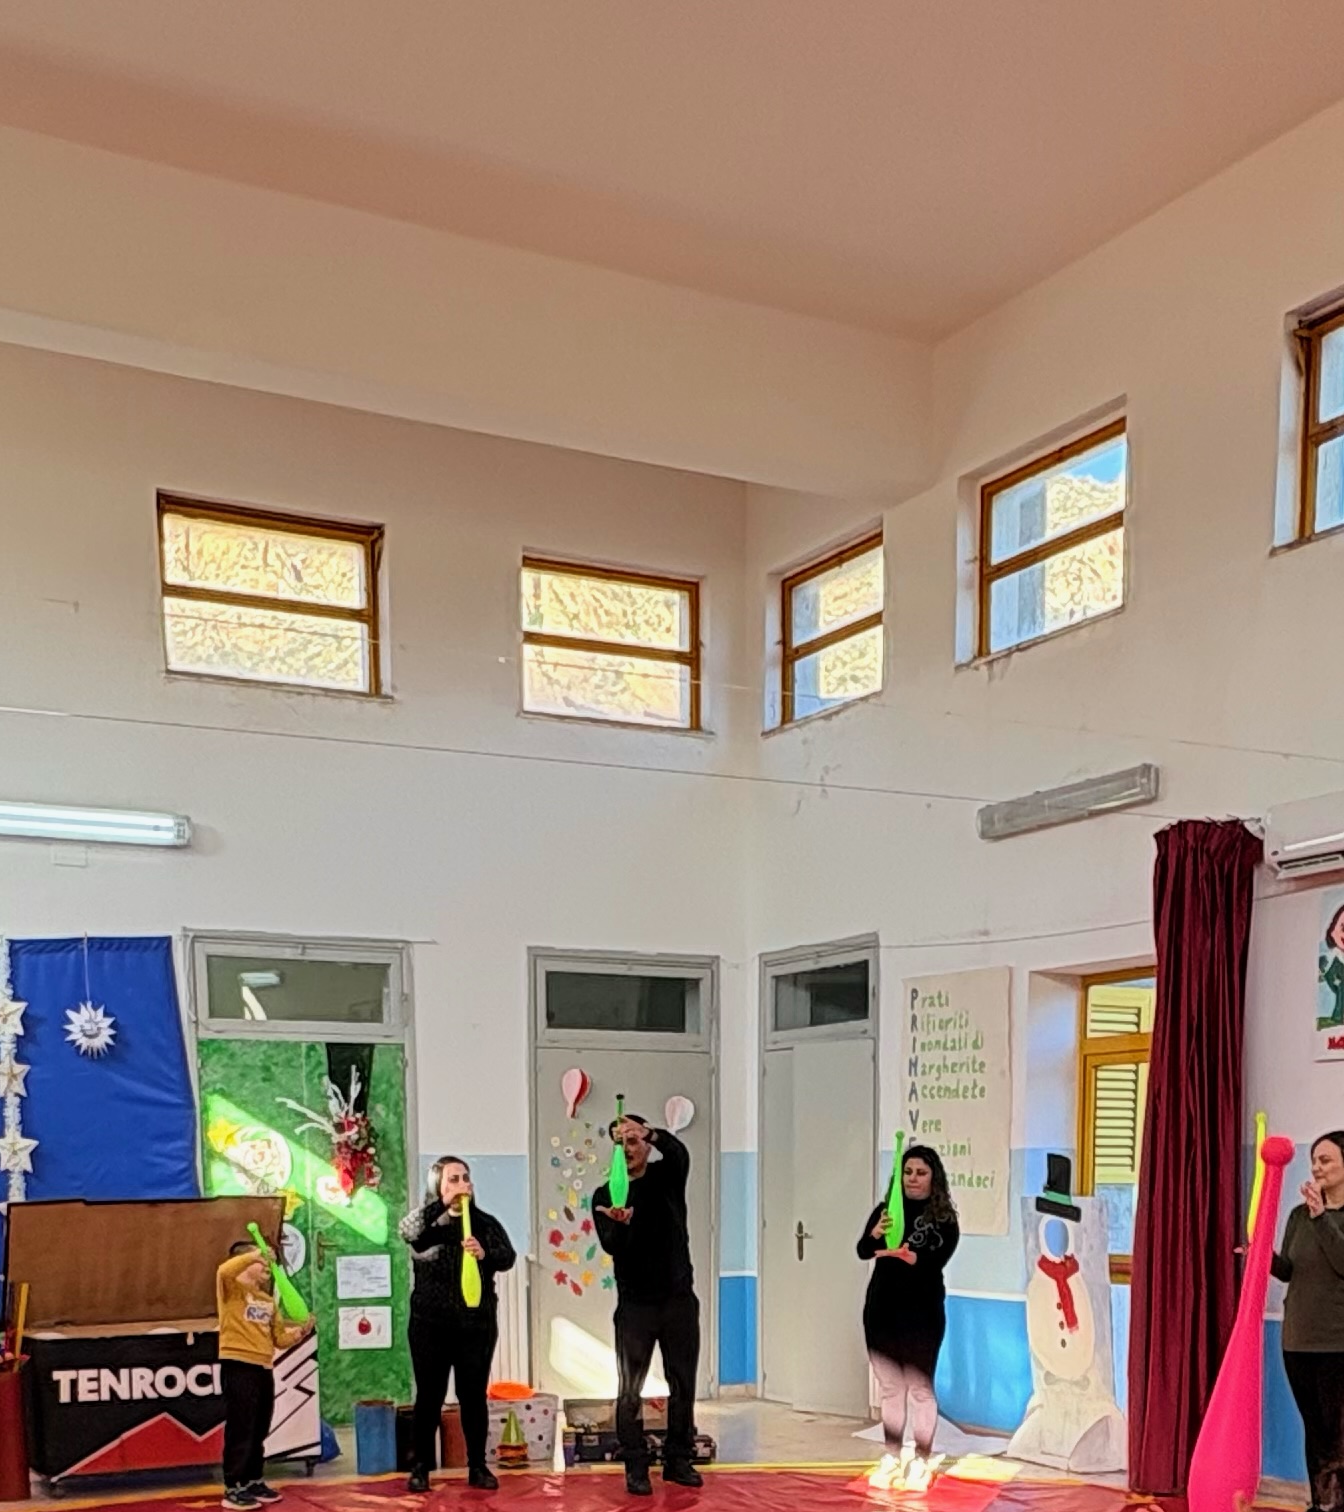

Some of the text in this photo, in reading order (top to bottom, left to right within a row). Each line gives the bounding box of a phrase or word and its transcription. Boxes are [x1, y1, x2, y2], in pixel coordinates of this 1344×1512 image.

[910, 987, 950, 1011] Prati
[908, 1055, 986, 1081] Margherite
[908, 1078, 986, 1102] Accendete
[909, 1109, 942, 1133] Vere
